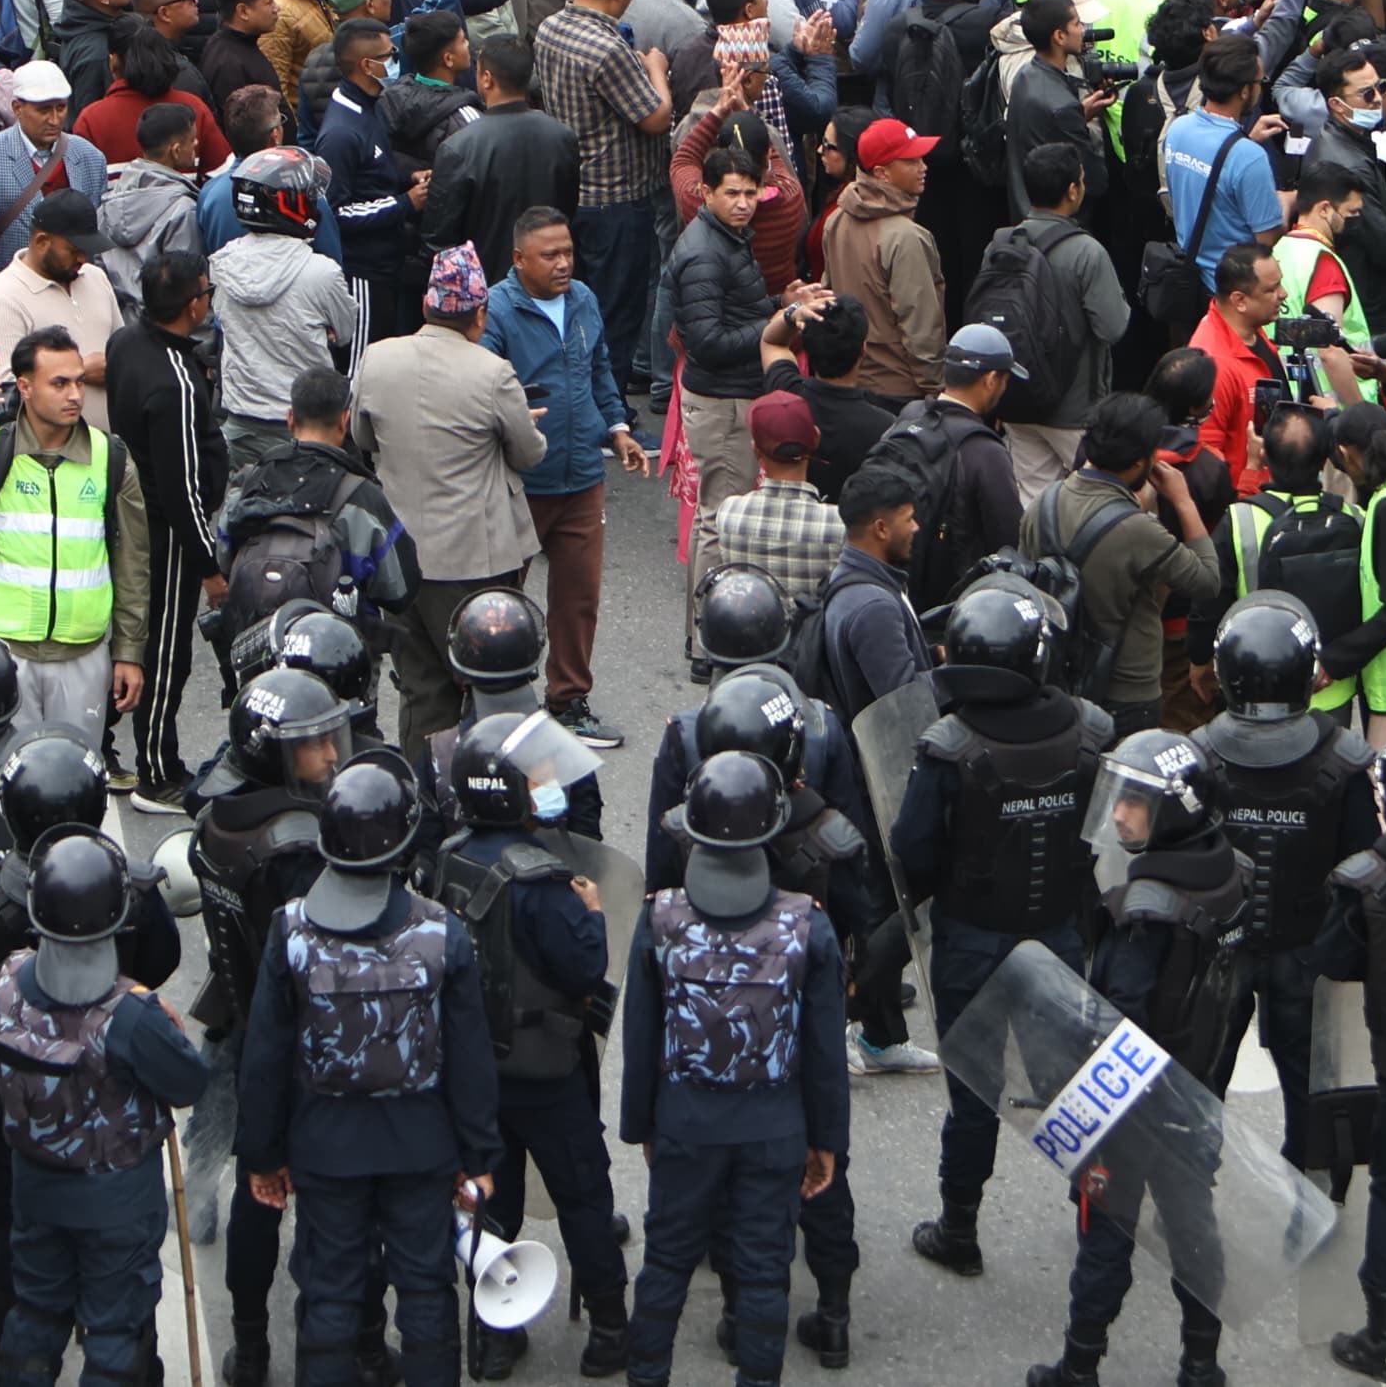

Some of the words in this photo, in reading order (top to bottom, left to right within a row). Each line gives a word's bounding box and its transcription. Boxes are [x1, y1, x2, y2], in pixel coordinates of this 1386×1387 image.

[15, 480, 41, 496] PRESS
[246, 698, 283, 722] POLICE
[251, 687, 286, 712] NEPAL
[468, 776, 508, 791] NEPAL
[1002, 798, 1035, 815] NEPAL
[1038, 792, 1075, 811] POLICE
[1228, 808, 1263, 822] NEPAL
[1266, 809, 1306, 824] POLICE
[1033, 1031, 1157, 1170] POLICE
